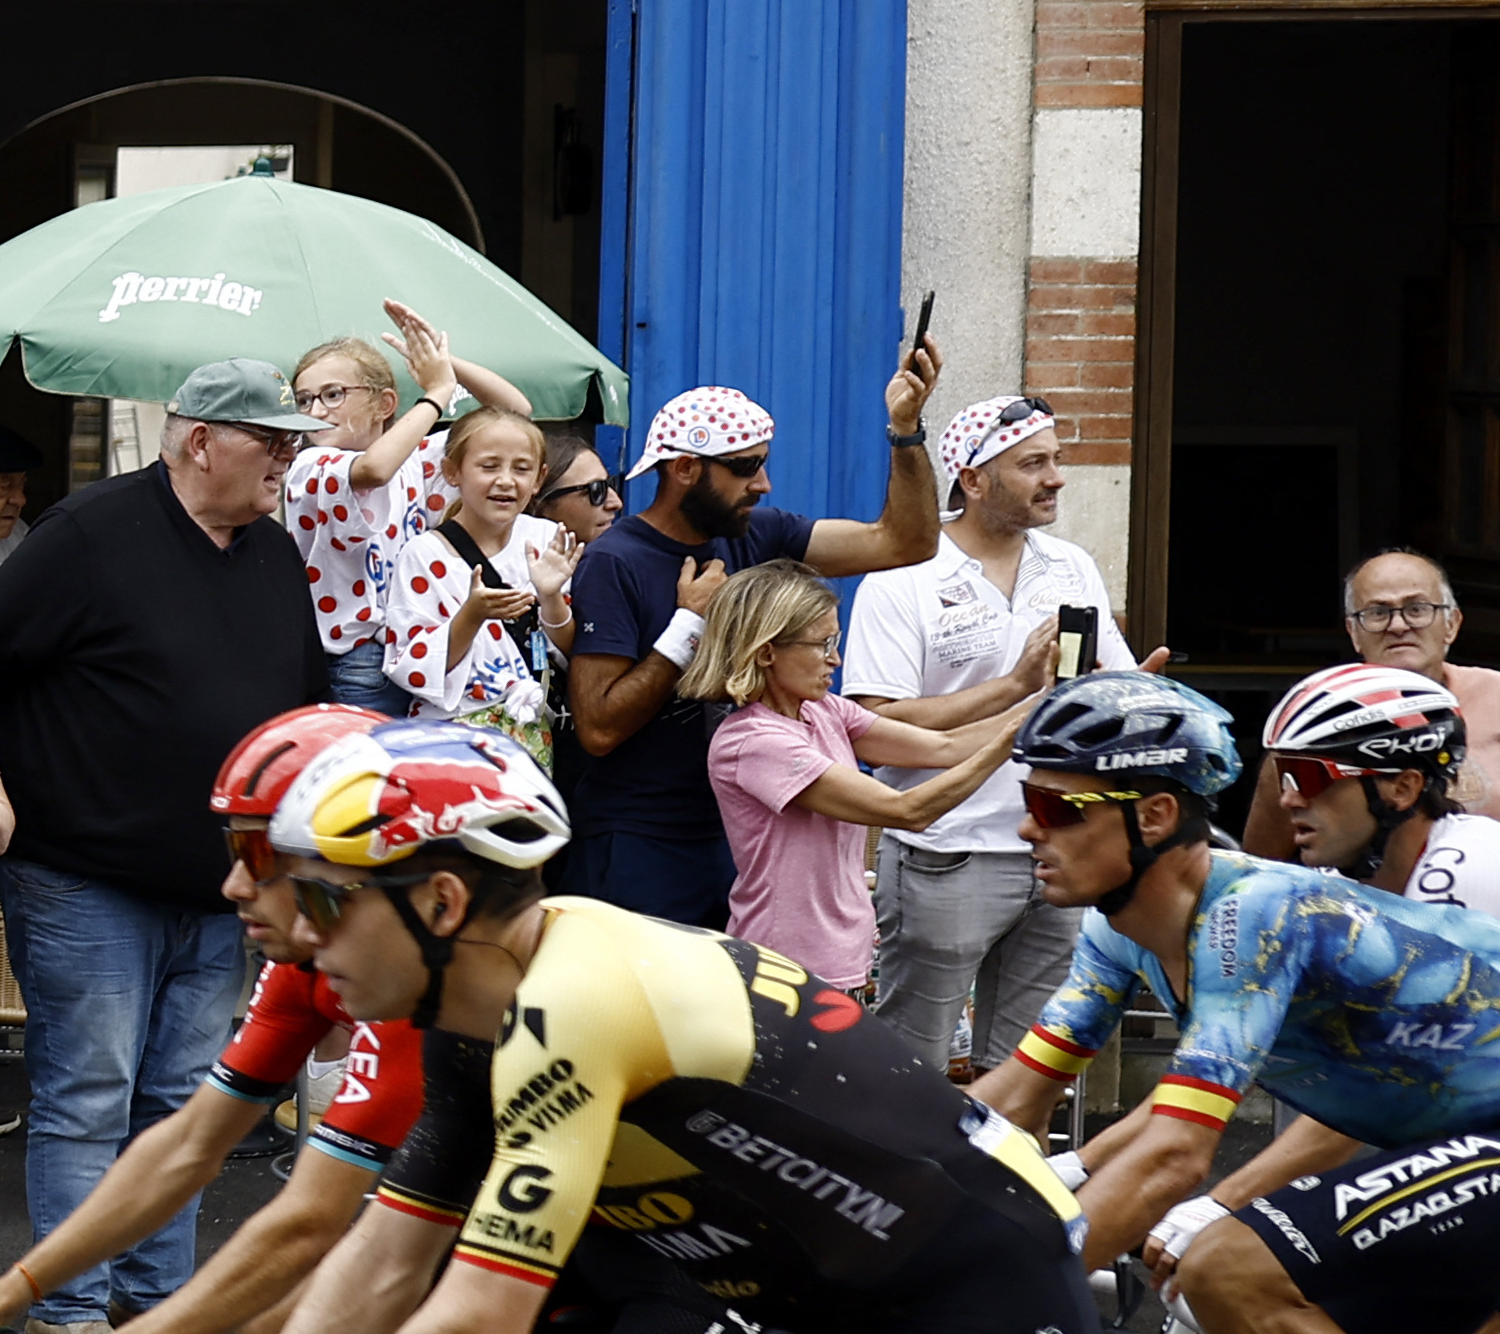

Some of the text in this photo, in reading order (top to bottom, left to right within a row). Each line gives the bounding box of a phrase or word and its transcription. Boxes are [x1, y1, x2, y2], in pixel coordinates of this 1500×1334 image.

[1096, 747, 1189, 772] LIMAR
[337, 1018, 381, 1104] KEA
[1386, 1021, 1476, 1052] KAZ
[528, 1083, 595, 1135] VISMA
[1334, 1133, 1500, 1222] ASTANA
[1351, 1171, 1500, 1253] QAZAQSTA
